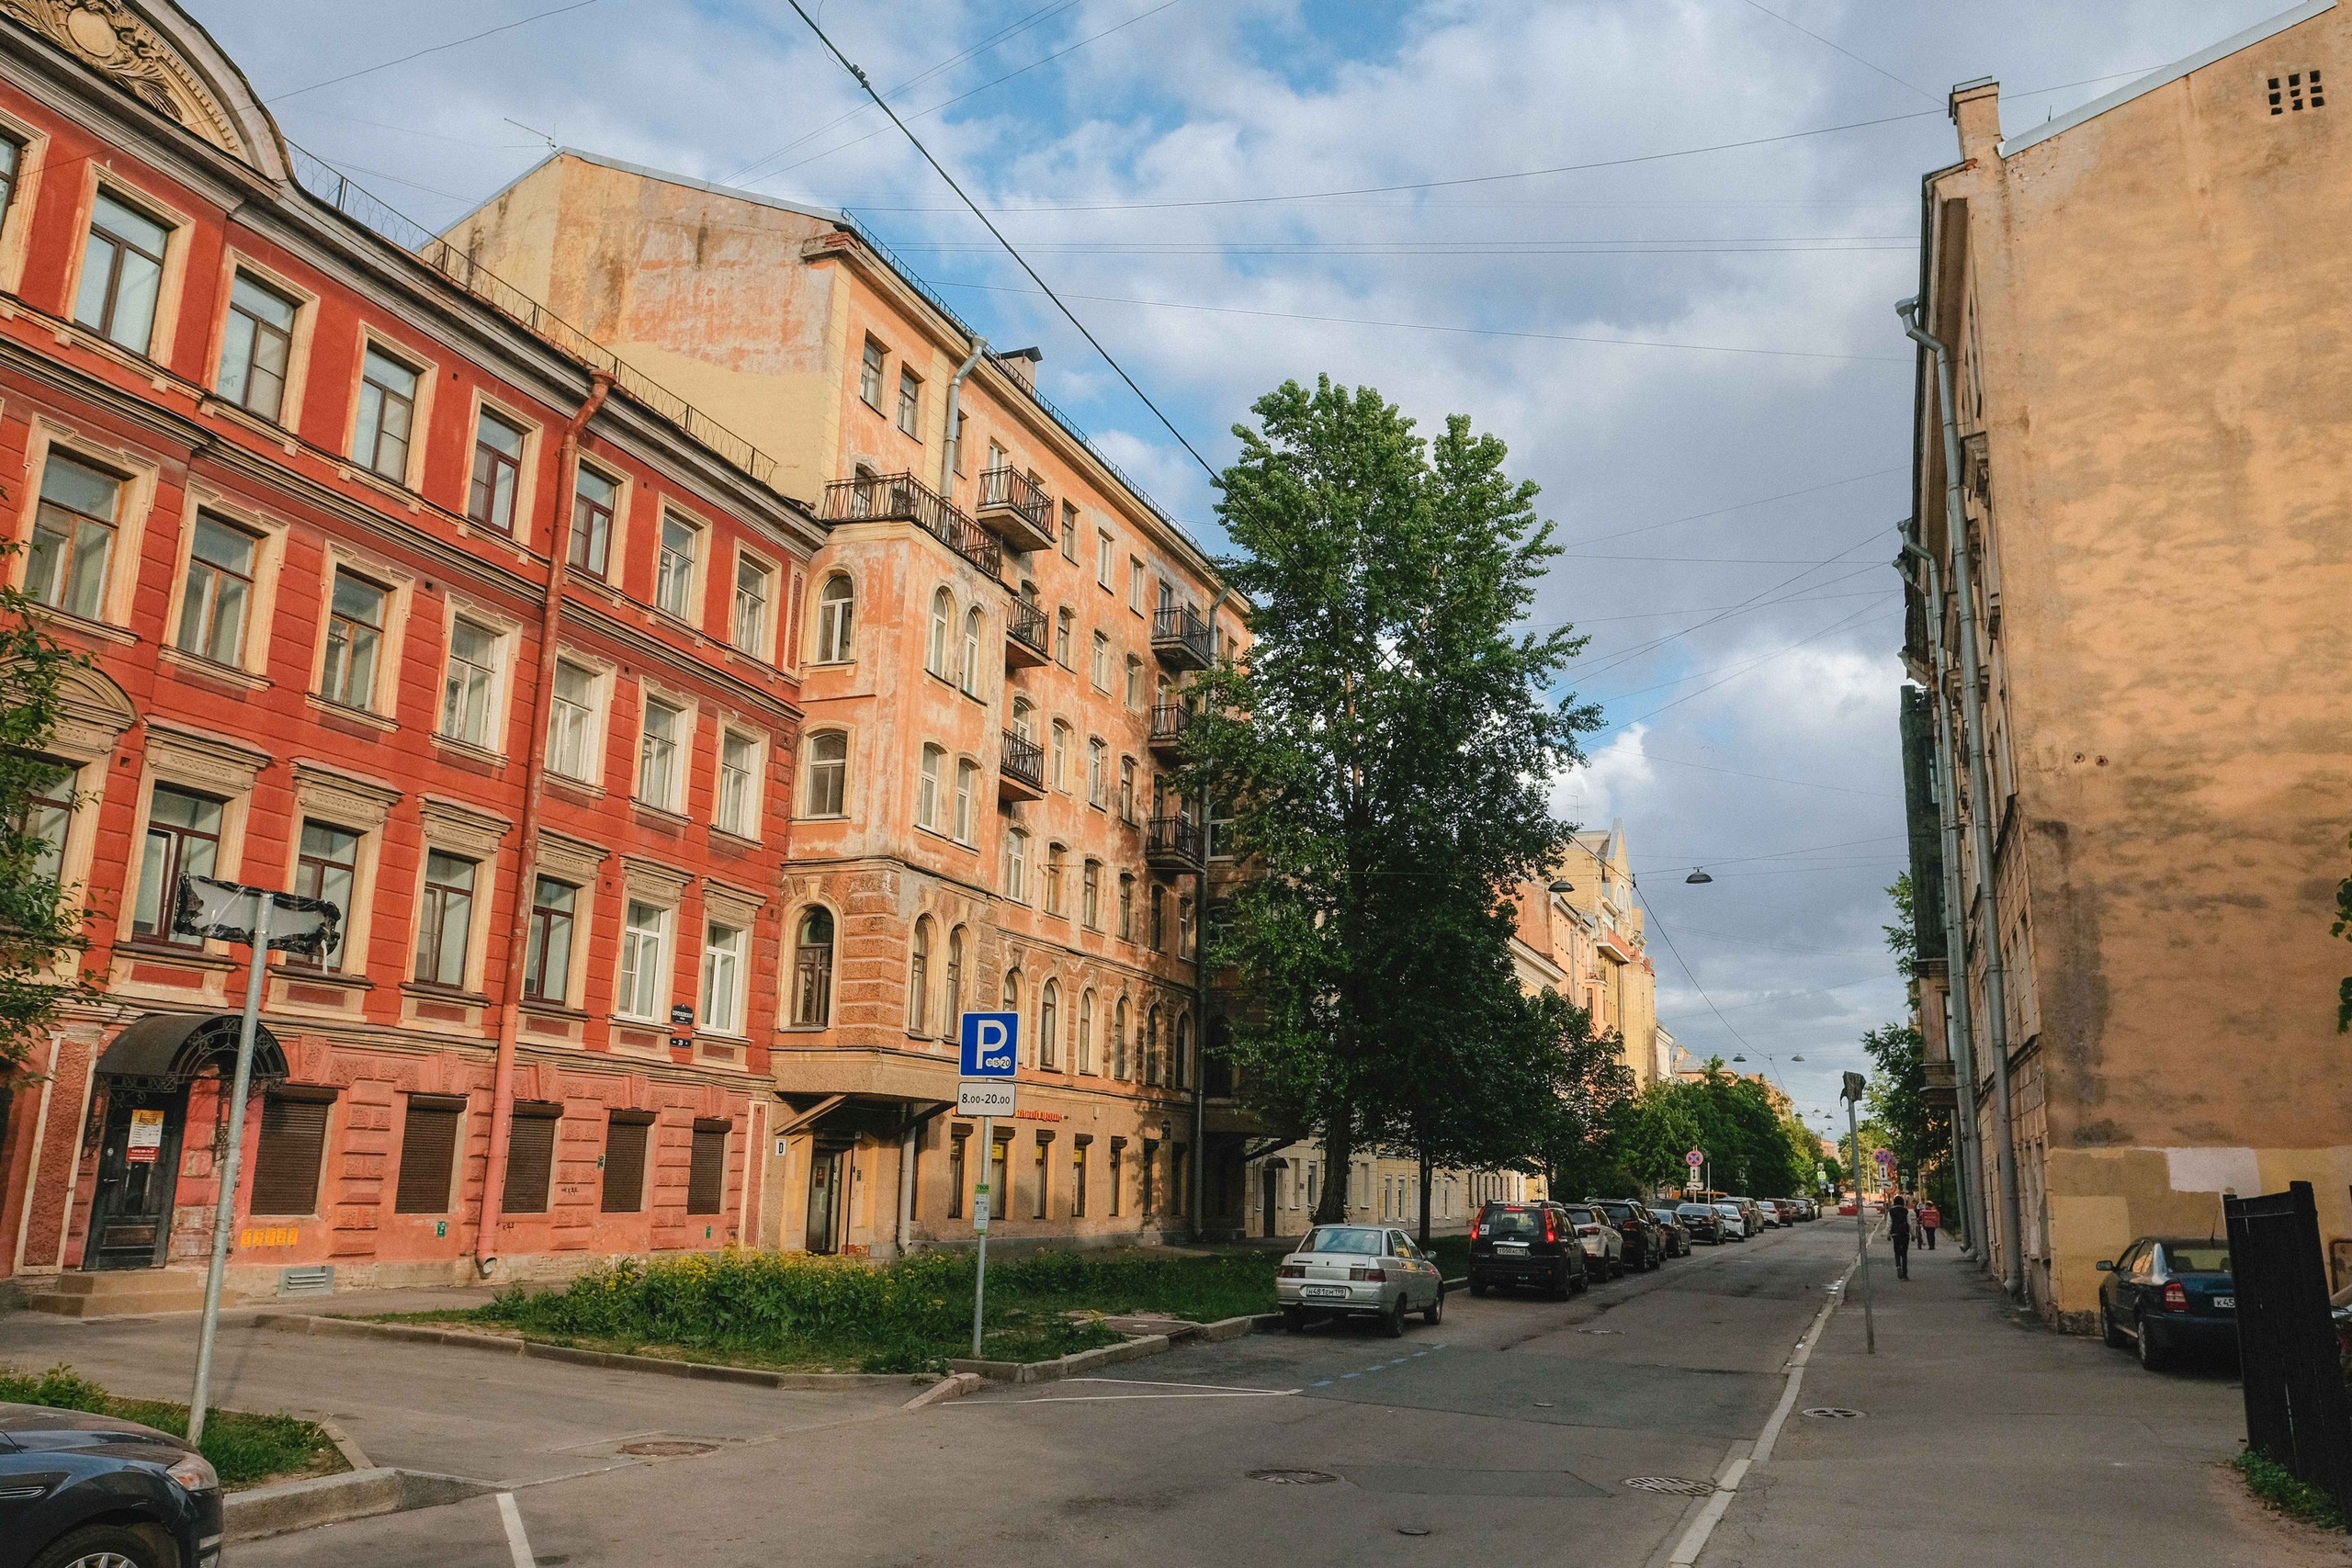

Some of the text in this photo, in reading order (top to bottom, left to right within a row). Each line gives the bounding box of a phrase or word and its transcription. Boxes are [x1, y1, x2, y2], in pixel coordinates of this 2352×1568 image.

[976, 1020, 1008, 1069] P
[961, 1093, 1011, 1105] 8.00-20.00
[2217, 1298, 2234, 1307] К45
